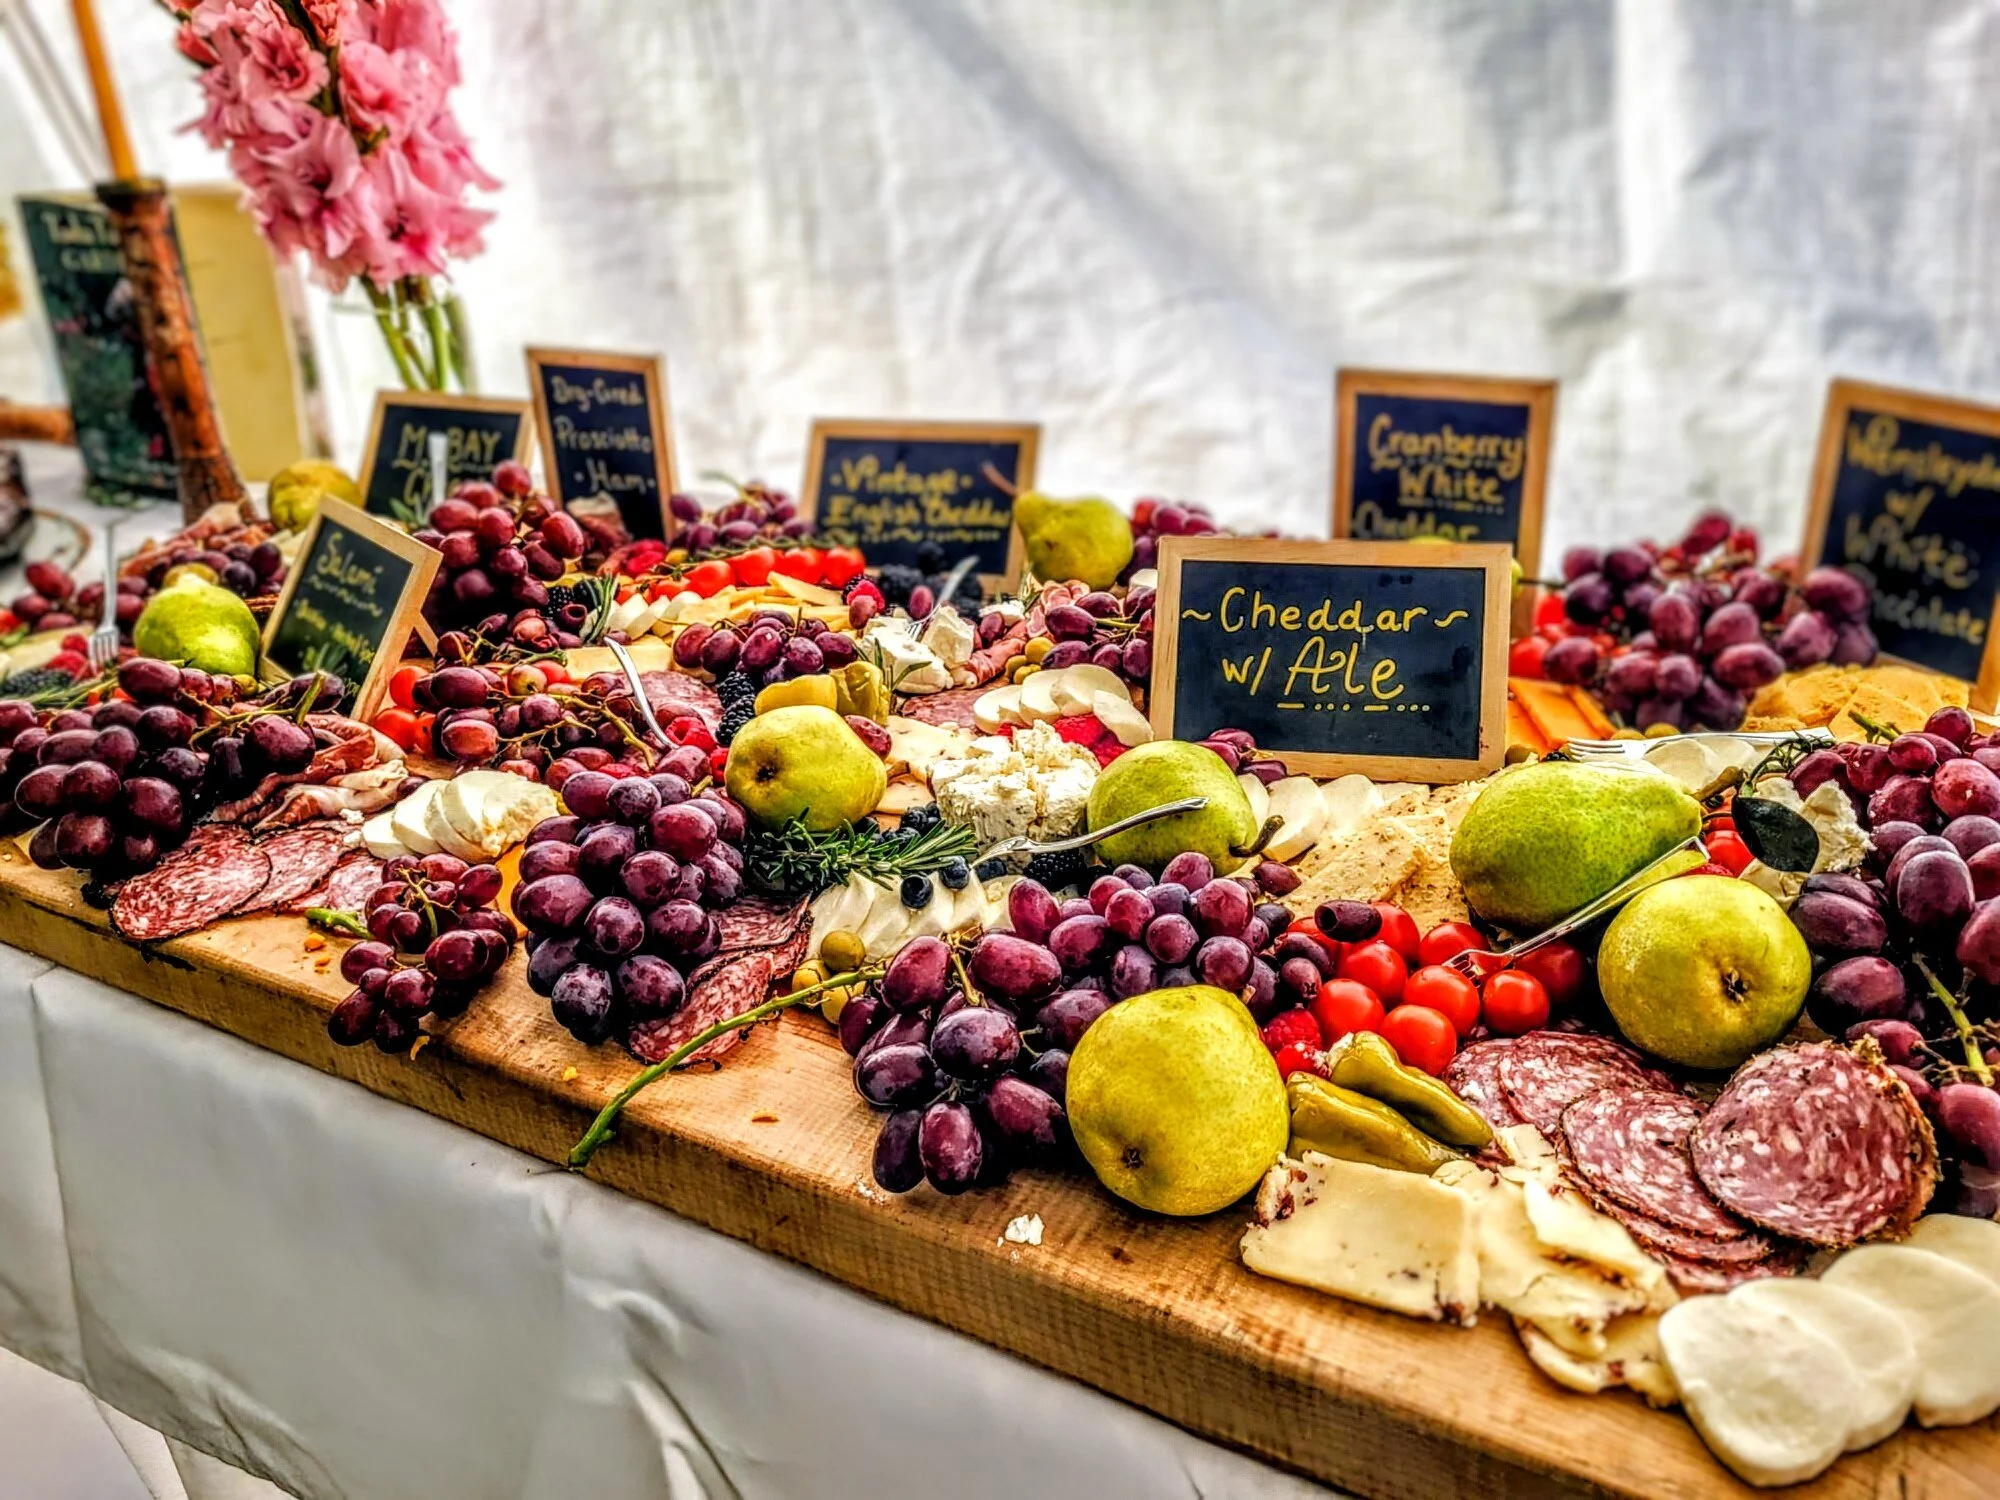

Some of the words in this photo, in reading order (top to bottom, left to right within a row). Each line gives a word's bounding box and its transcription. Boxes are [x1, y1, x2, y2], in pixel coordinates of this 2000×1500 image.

[395, 422, 502, 463] MBAY
[1368, 413, 1526, 480] Cranberry
[841, 454, 958, 506] Vintage
[1400, 463, 1504, 505] White
[823, 496, 920, 535] English
[1845, 514, 1979, 589] White
[1220, 586, 1428, 634] Cheddar
[1221, 646, 1273, 696] w/
[1284, 635, 1404, 700] Ale
